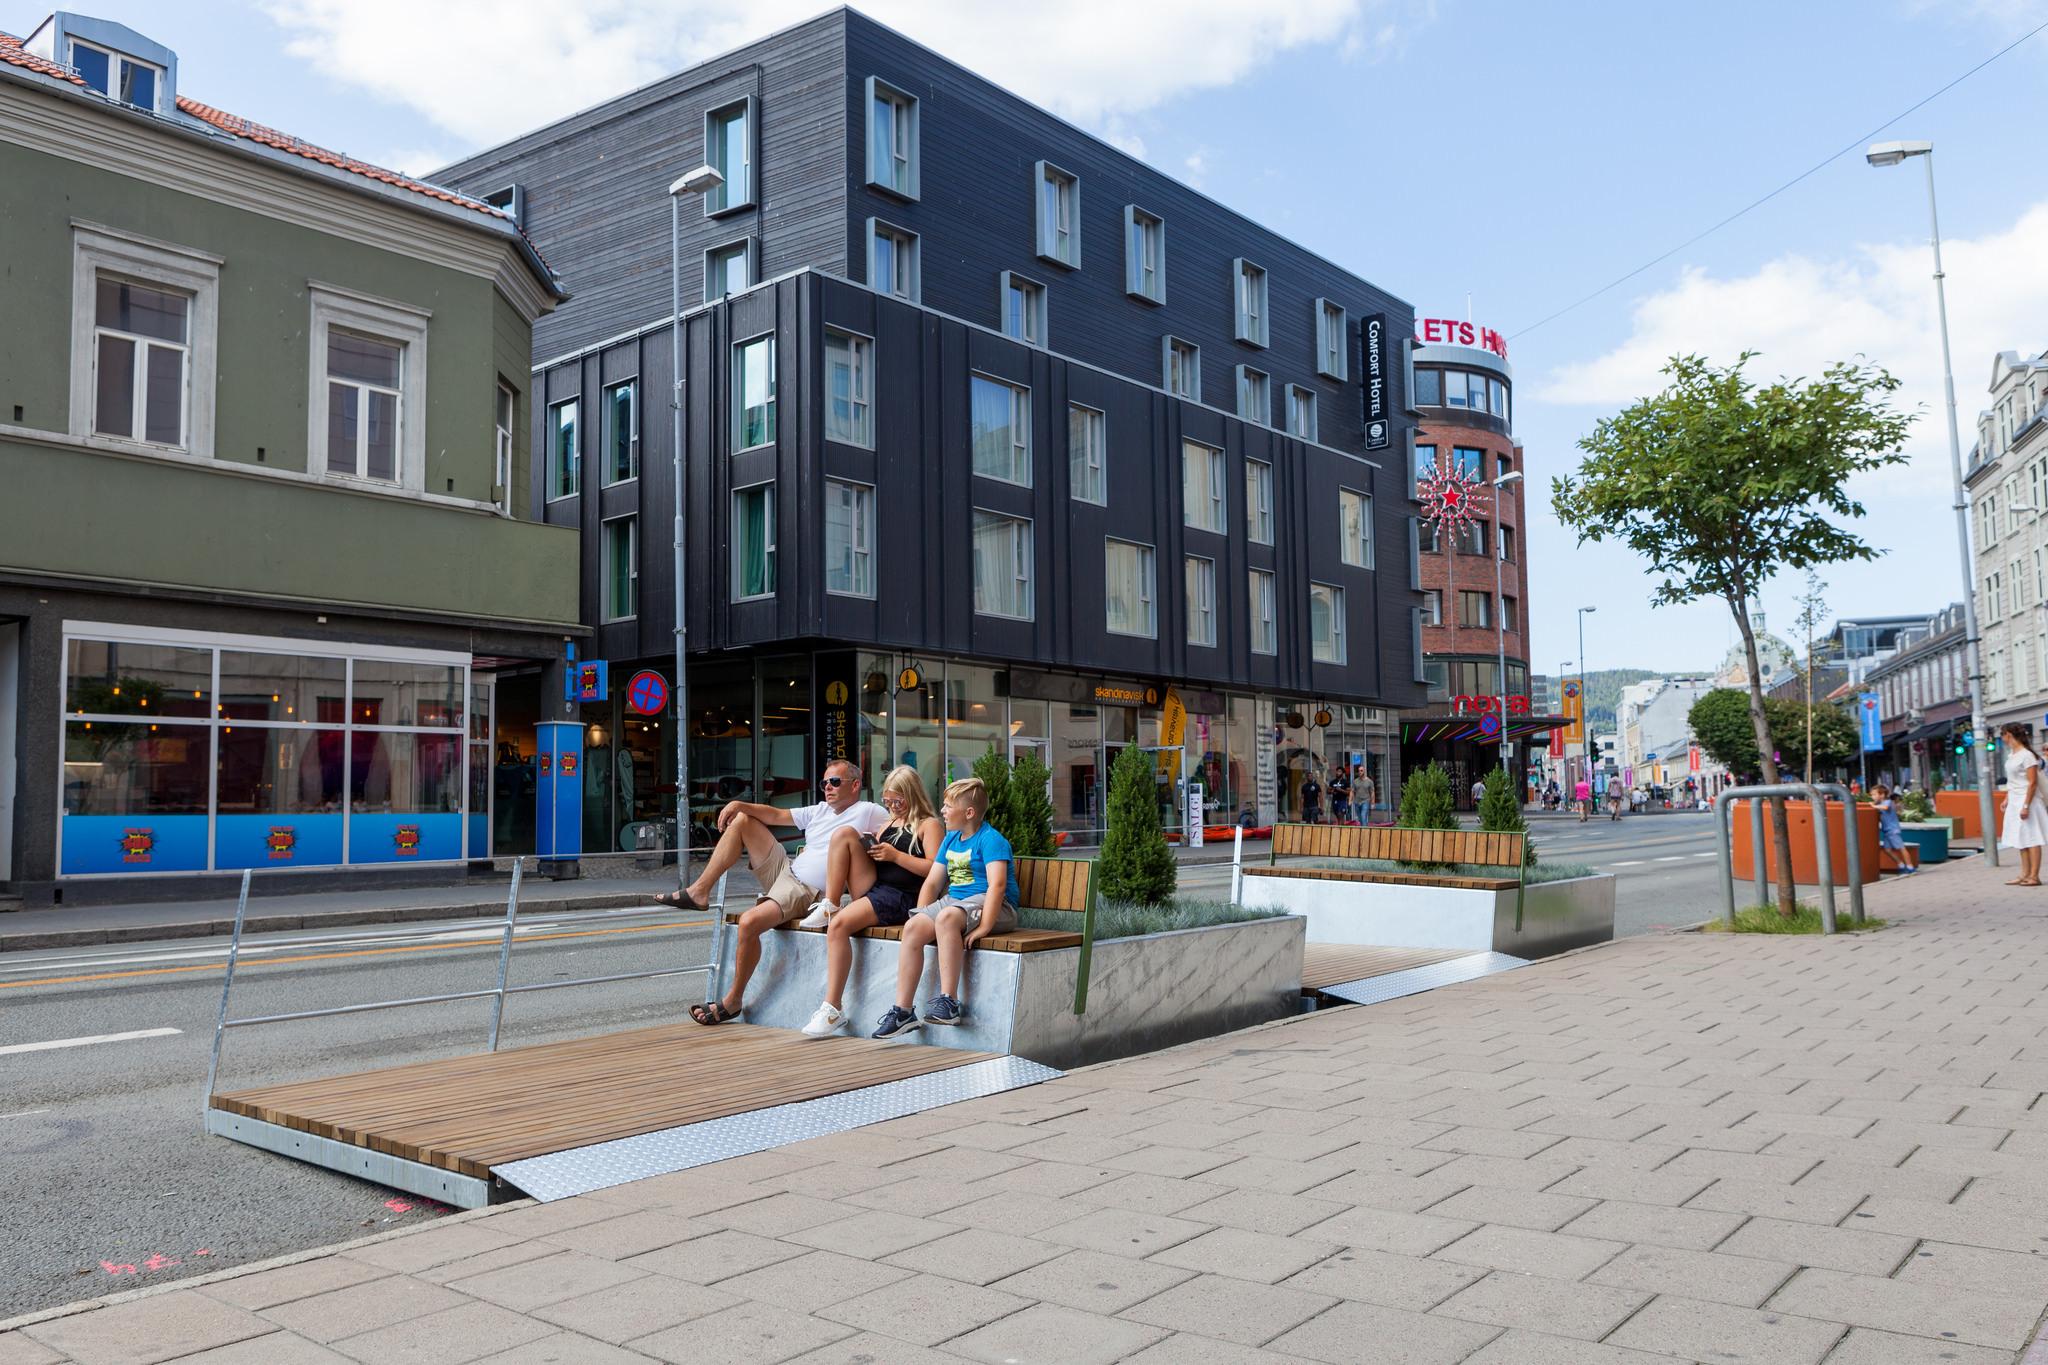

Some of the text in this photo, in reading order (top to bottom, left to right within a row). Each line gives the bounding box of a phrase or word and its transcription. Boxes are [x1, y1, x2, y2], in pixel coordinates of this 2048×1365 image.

[1095, 686, 1144, 701] skandinavisk
[1455, 695, 1530, 713] nova
[1165, 706, 1180, 768] skadinavisk
